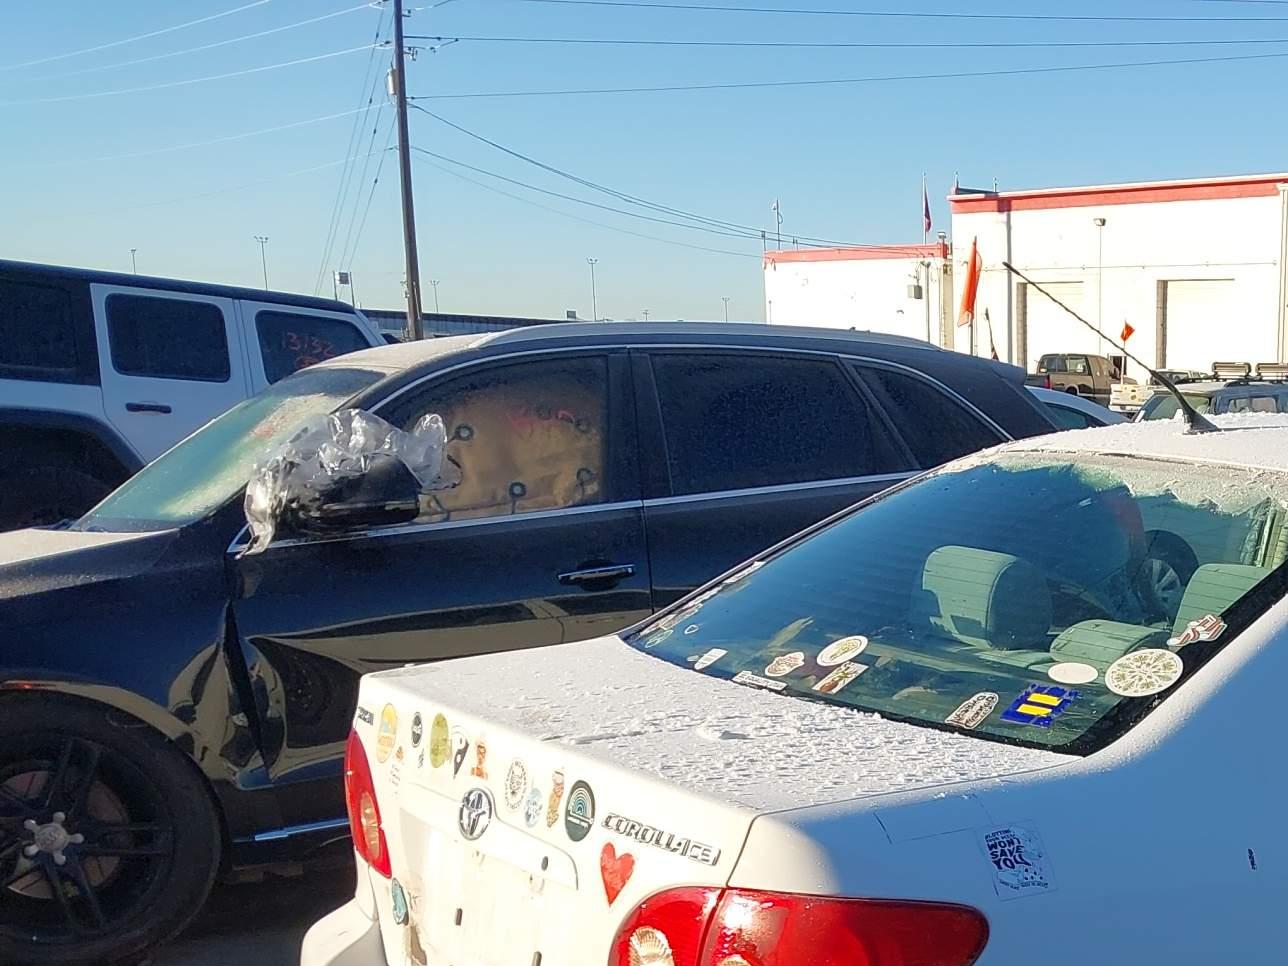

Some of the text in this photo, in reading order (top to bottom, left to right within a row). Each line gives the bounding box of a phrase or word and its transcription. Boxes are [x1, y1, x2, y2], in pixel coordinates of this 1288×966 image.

[602, 812, 692, 857] COROLLA
[990, 845, 1024, 860] SAVE
[992, 853, 1032, 871] YOU
